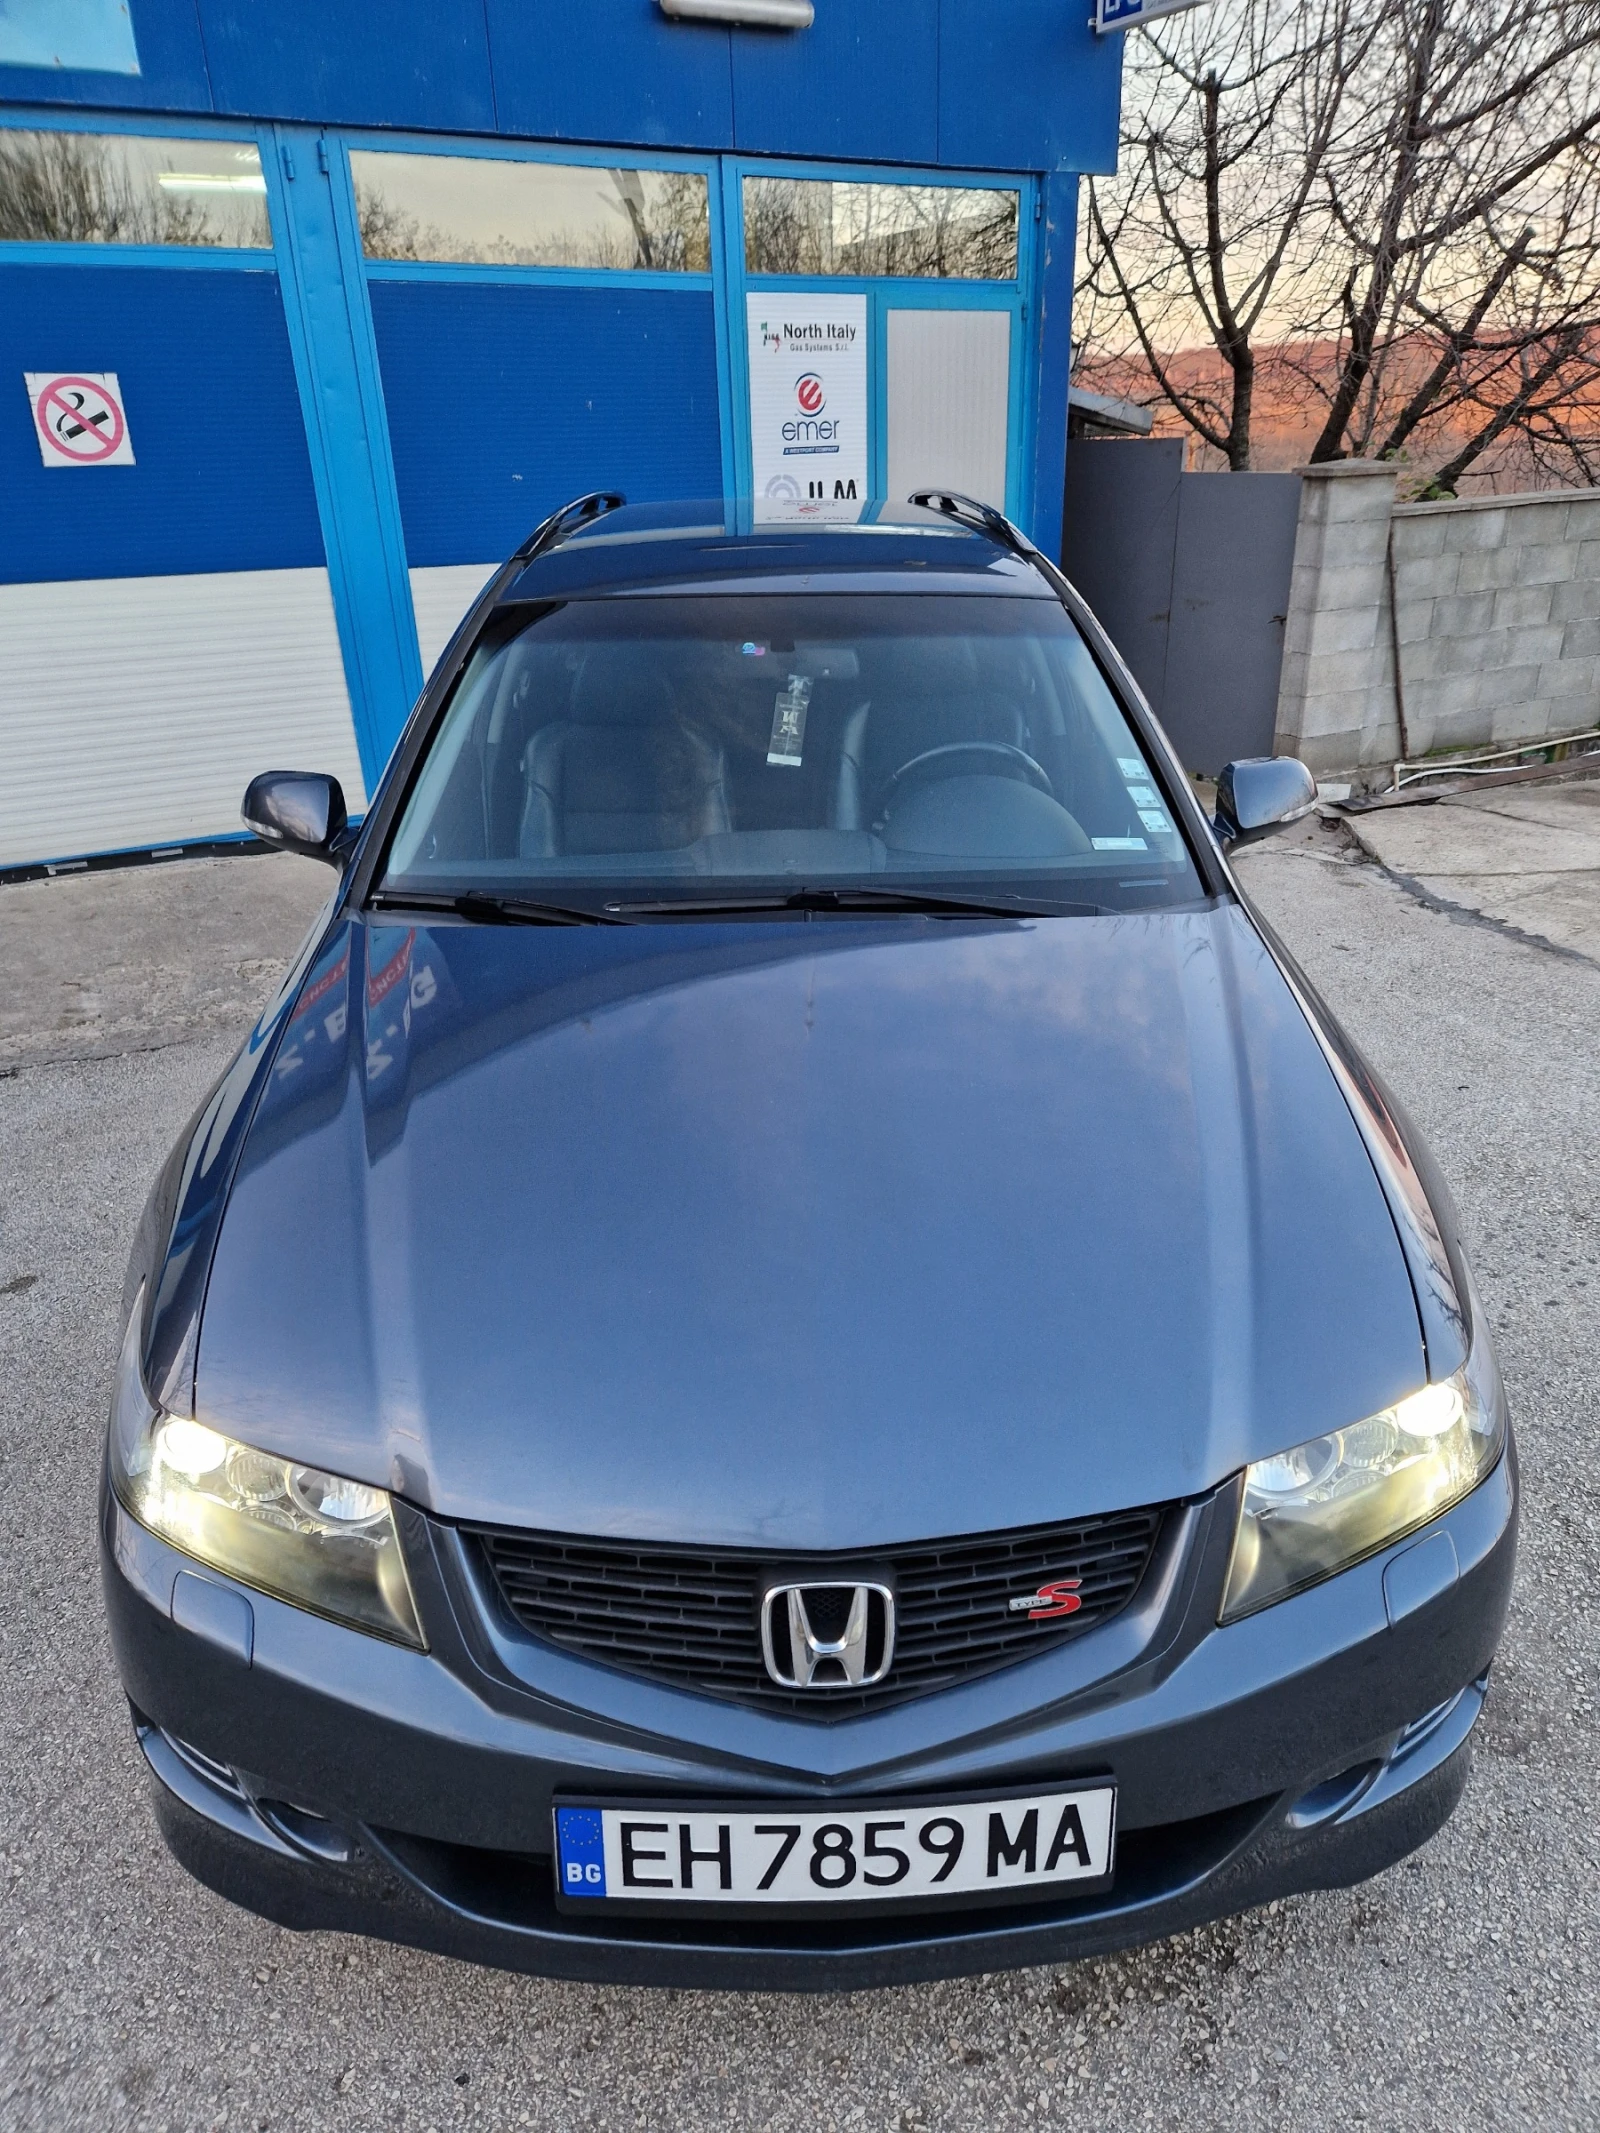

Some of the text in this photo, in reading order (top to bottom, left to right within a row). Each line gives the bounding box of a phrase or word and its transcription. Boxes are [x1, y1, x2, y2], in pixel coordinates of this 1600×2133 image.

[783, 323, 822, 339] North
[827, 323, 856, 342] Italy
[790, 343, 803, 352] Gas
[804, 343, 833, 353] Systems
[781, 420, 840, 441] emer
[1015, 1580, 1083, 1619] TYPE S
[619, 1803, 1092, 1891] EH 7859 MA
[566, 1861, 602, 1884] BG
